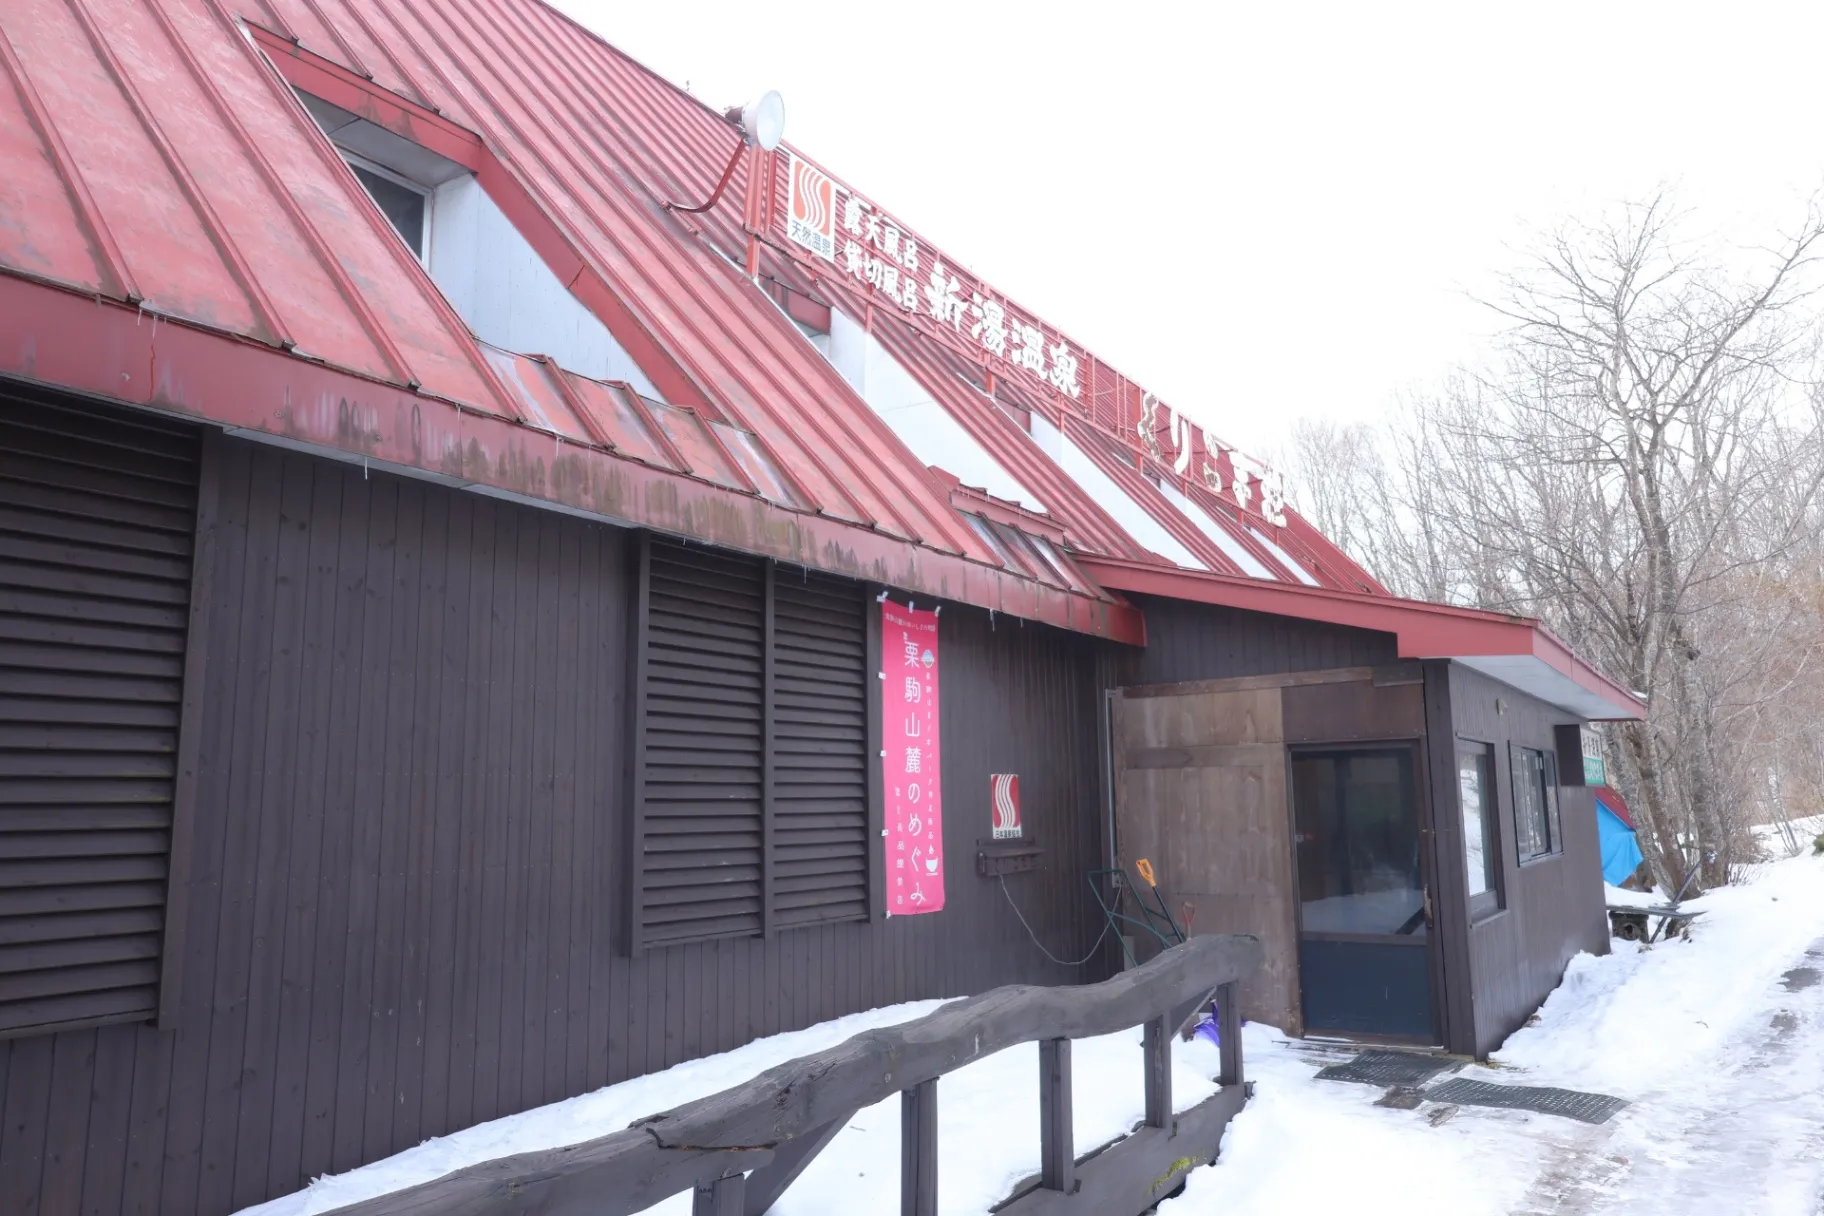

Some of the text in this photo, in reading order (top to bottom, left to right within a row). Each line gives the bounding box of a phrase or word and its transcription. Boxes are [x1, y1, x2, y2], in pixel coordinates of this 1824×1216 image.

[791, 219, 831, 258] 天然温泉
[844, 198, 919, 273] 露天風呂
[844, 239, 919, 312] 貸切風呂
[924, 260, 1080, 399] 新湯温泉
[904, 641, 926, 906] 栗駒山麓のめぐみ
